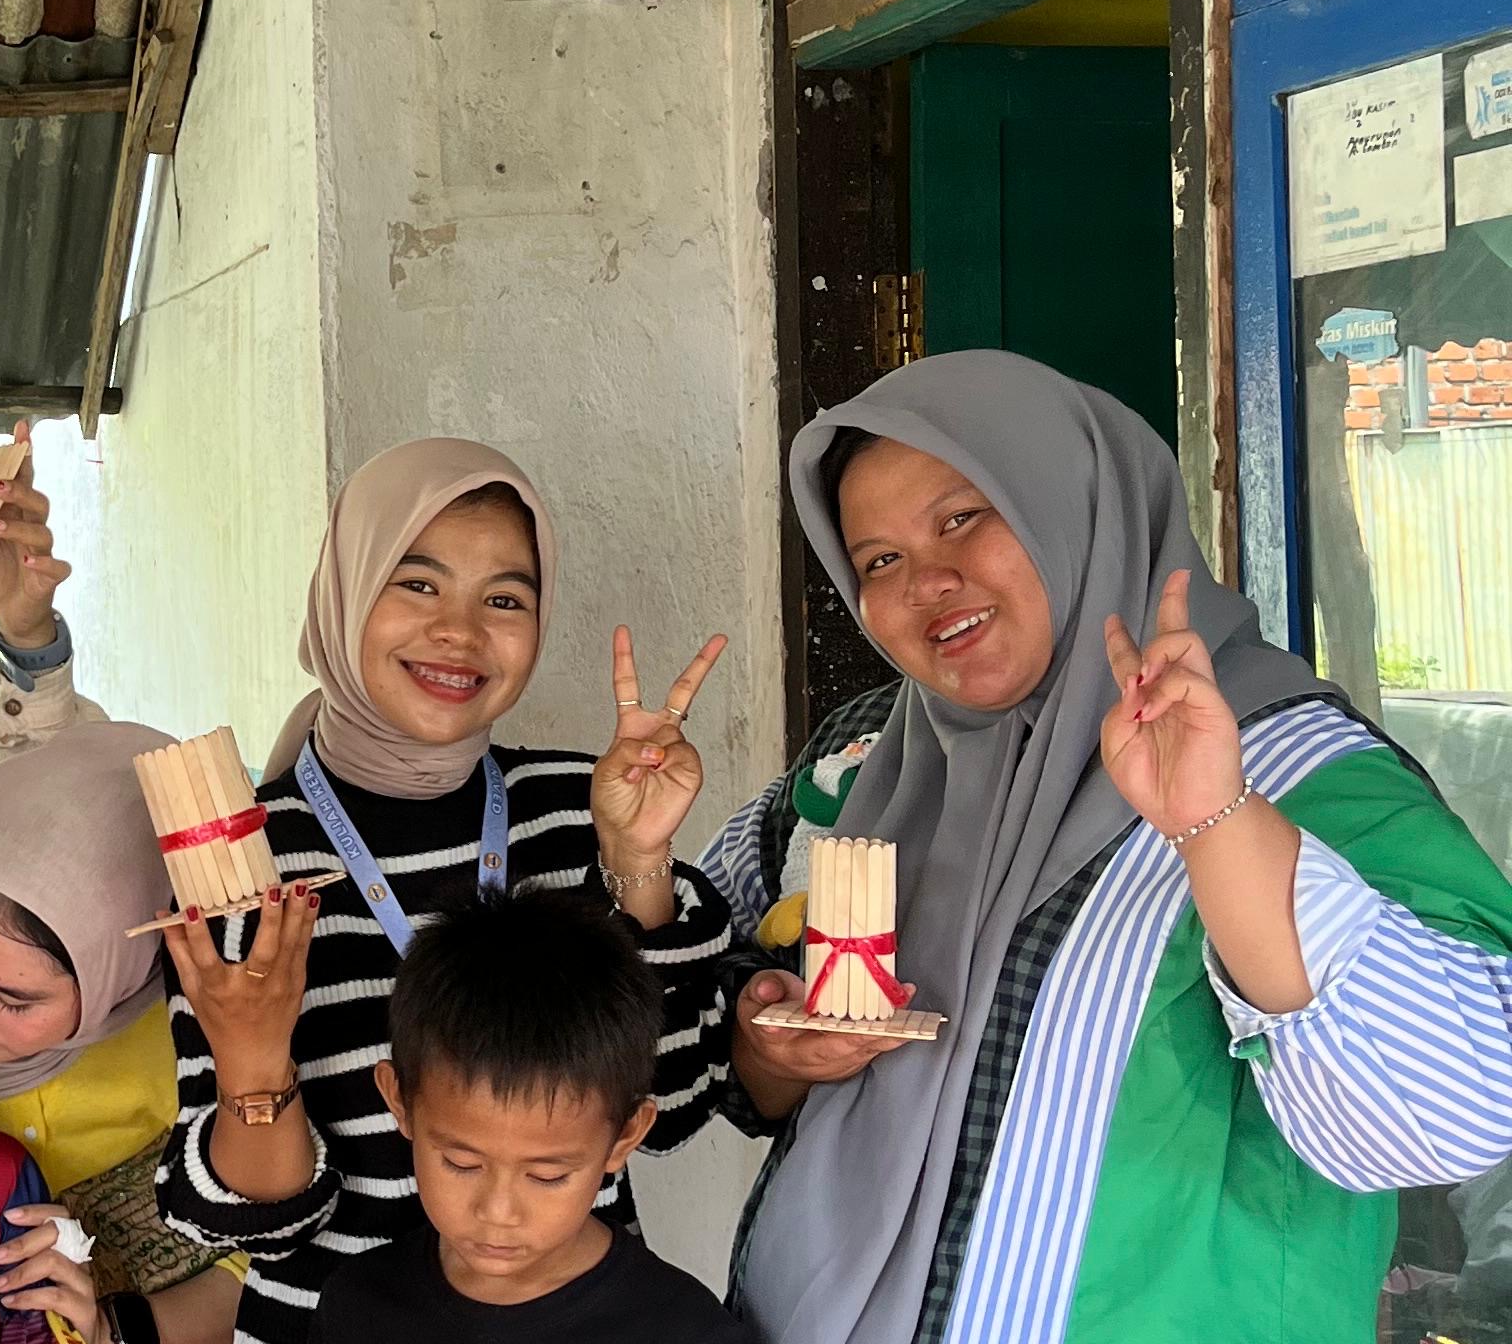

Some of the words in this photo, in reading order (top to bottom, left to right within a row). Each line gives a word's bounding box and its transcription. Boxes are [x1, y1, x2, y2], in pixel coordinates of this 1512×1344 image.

[1315, 327, 1342, 346] ras
[1346, 318, 1397, 340] Miskin
[318, 797, 363, 861] KULIAH
